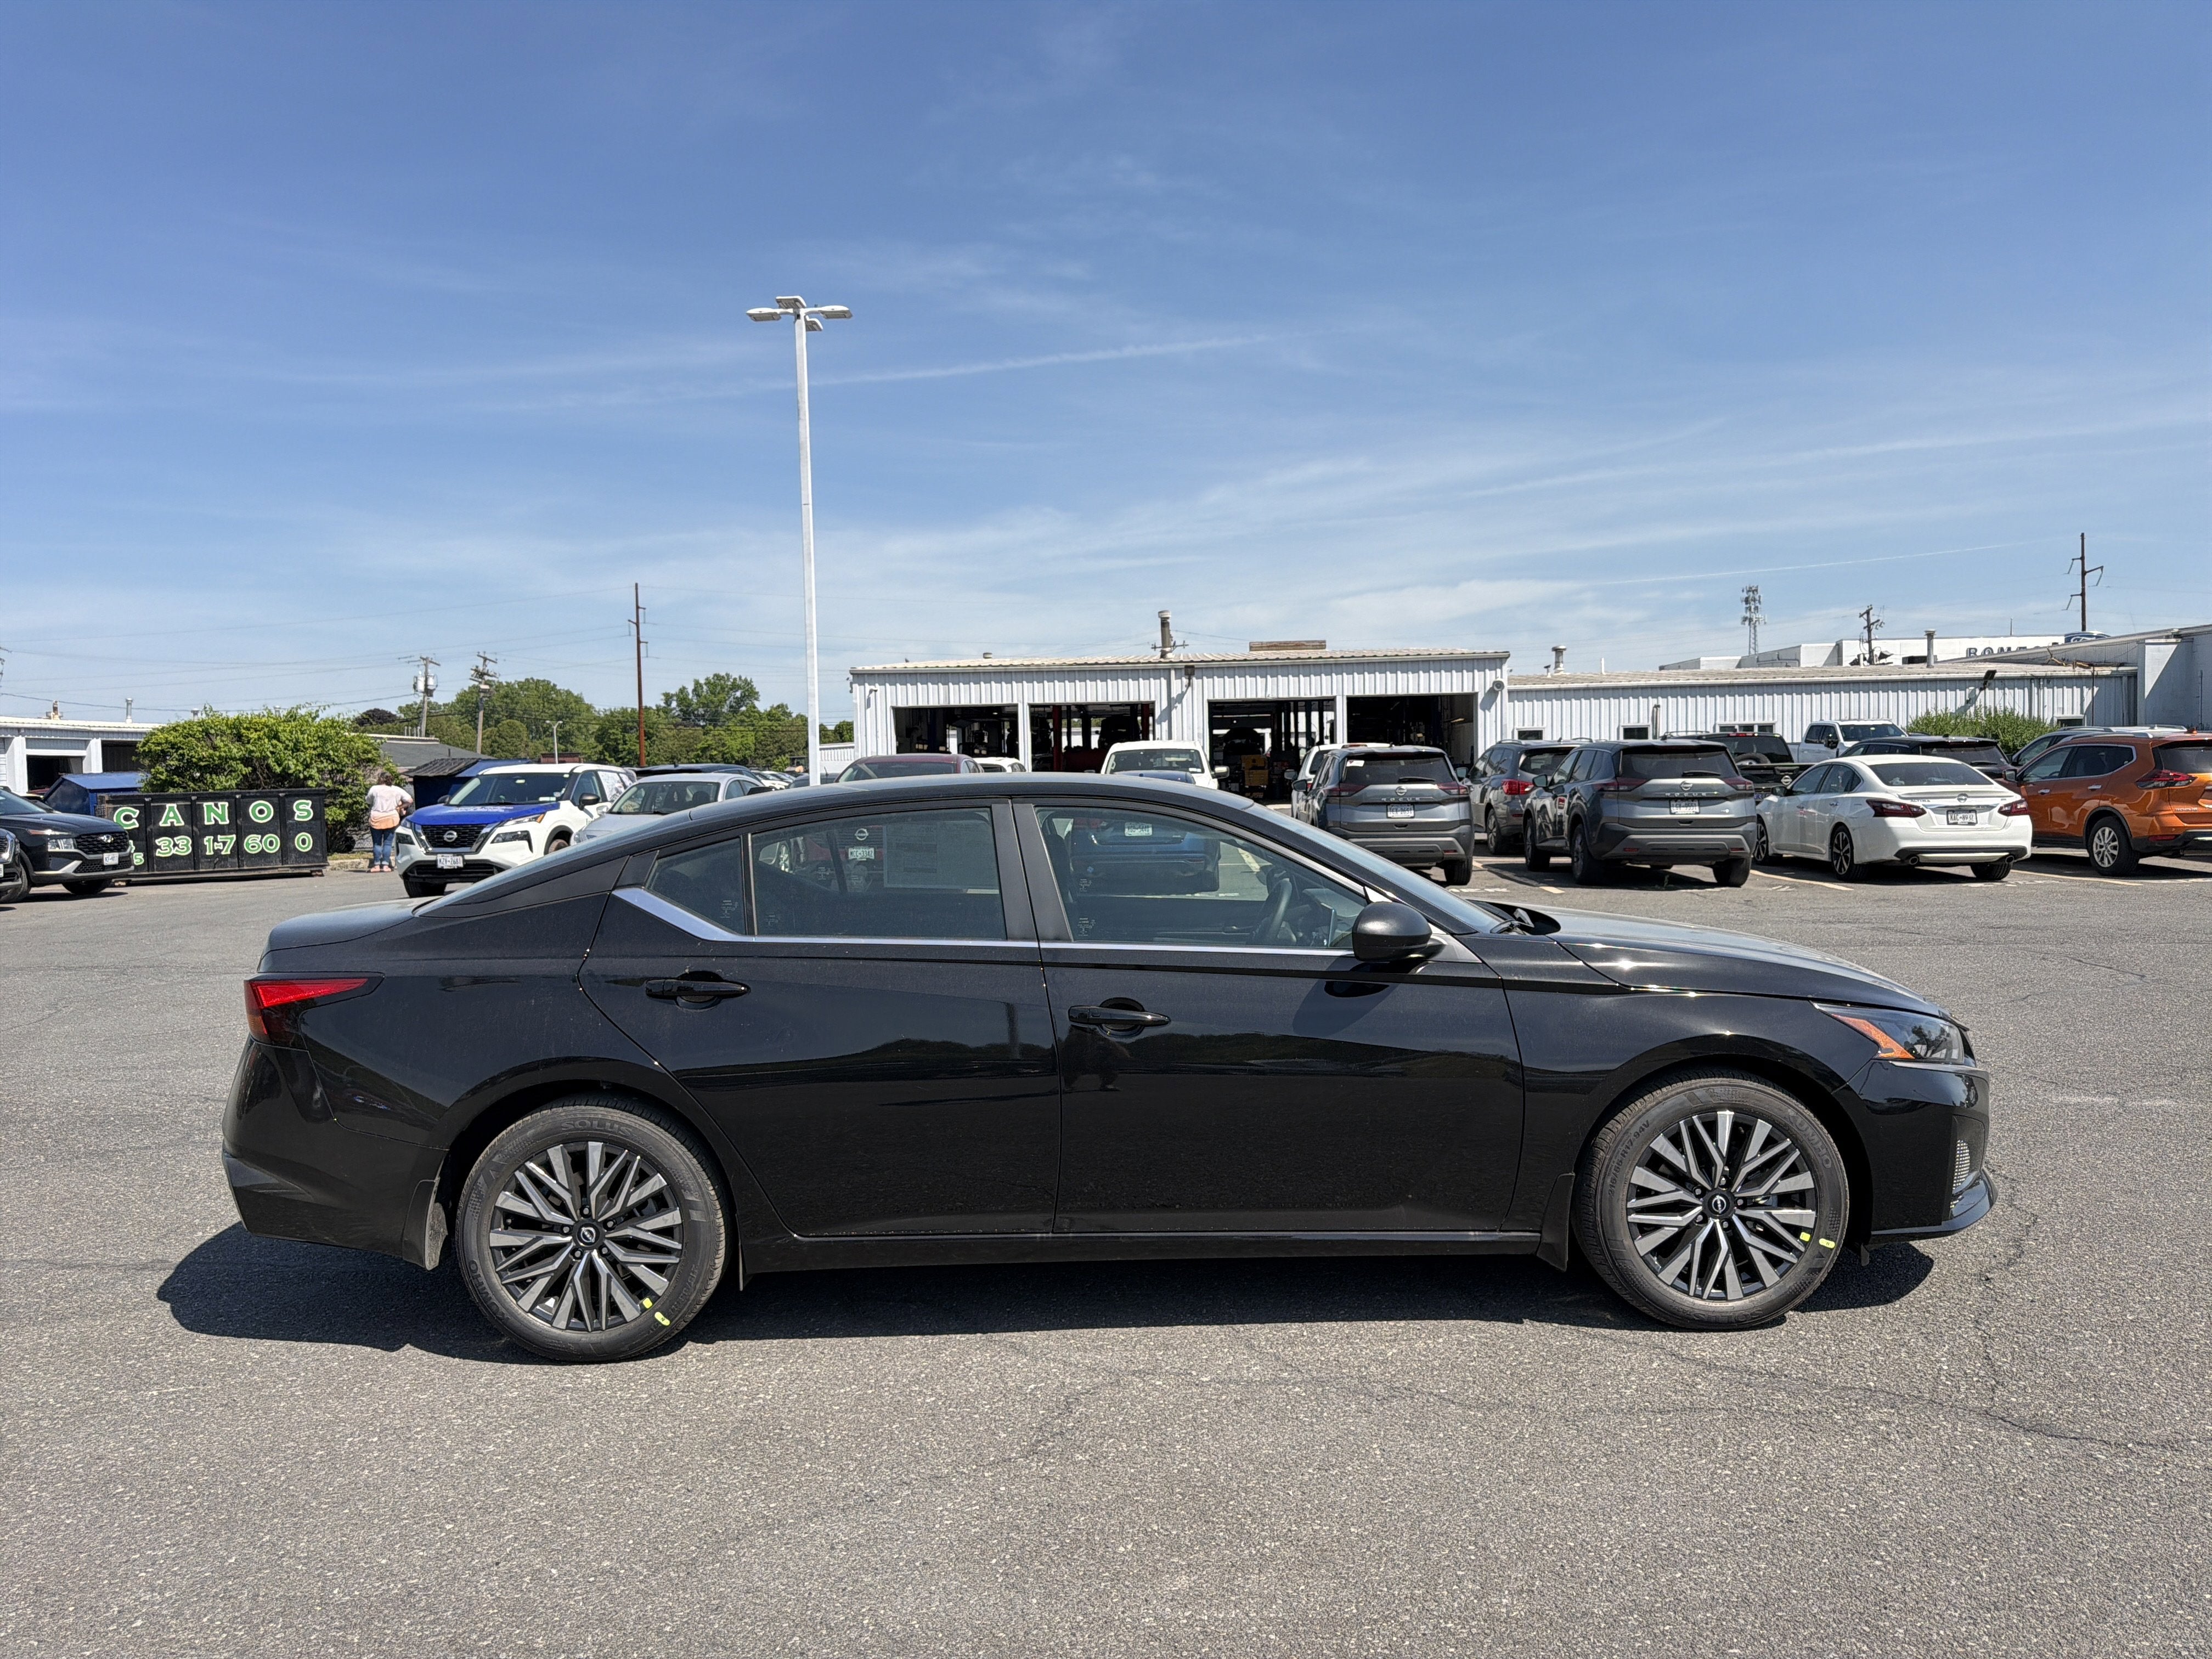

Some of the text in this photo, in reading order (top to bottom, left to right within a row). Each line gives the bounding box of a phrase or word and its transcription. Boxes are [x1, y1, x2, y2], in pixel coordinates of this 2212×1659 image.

[561, 1119, 632, 1137] SOLUS
[1620, 1139, 1633, 1159] R17
[1633, 1120, 1650, 1139] 94V
[1788, 1111, 1831, 1169] KUMHO
[469, 1260, 510, 1322] KUMHO
